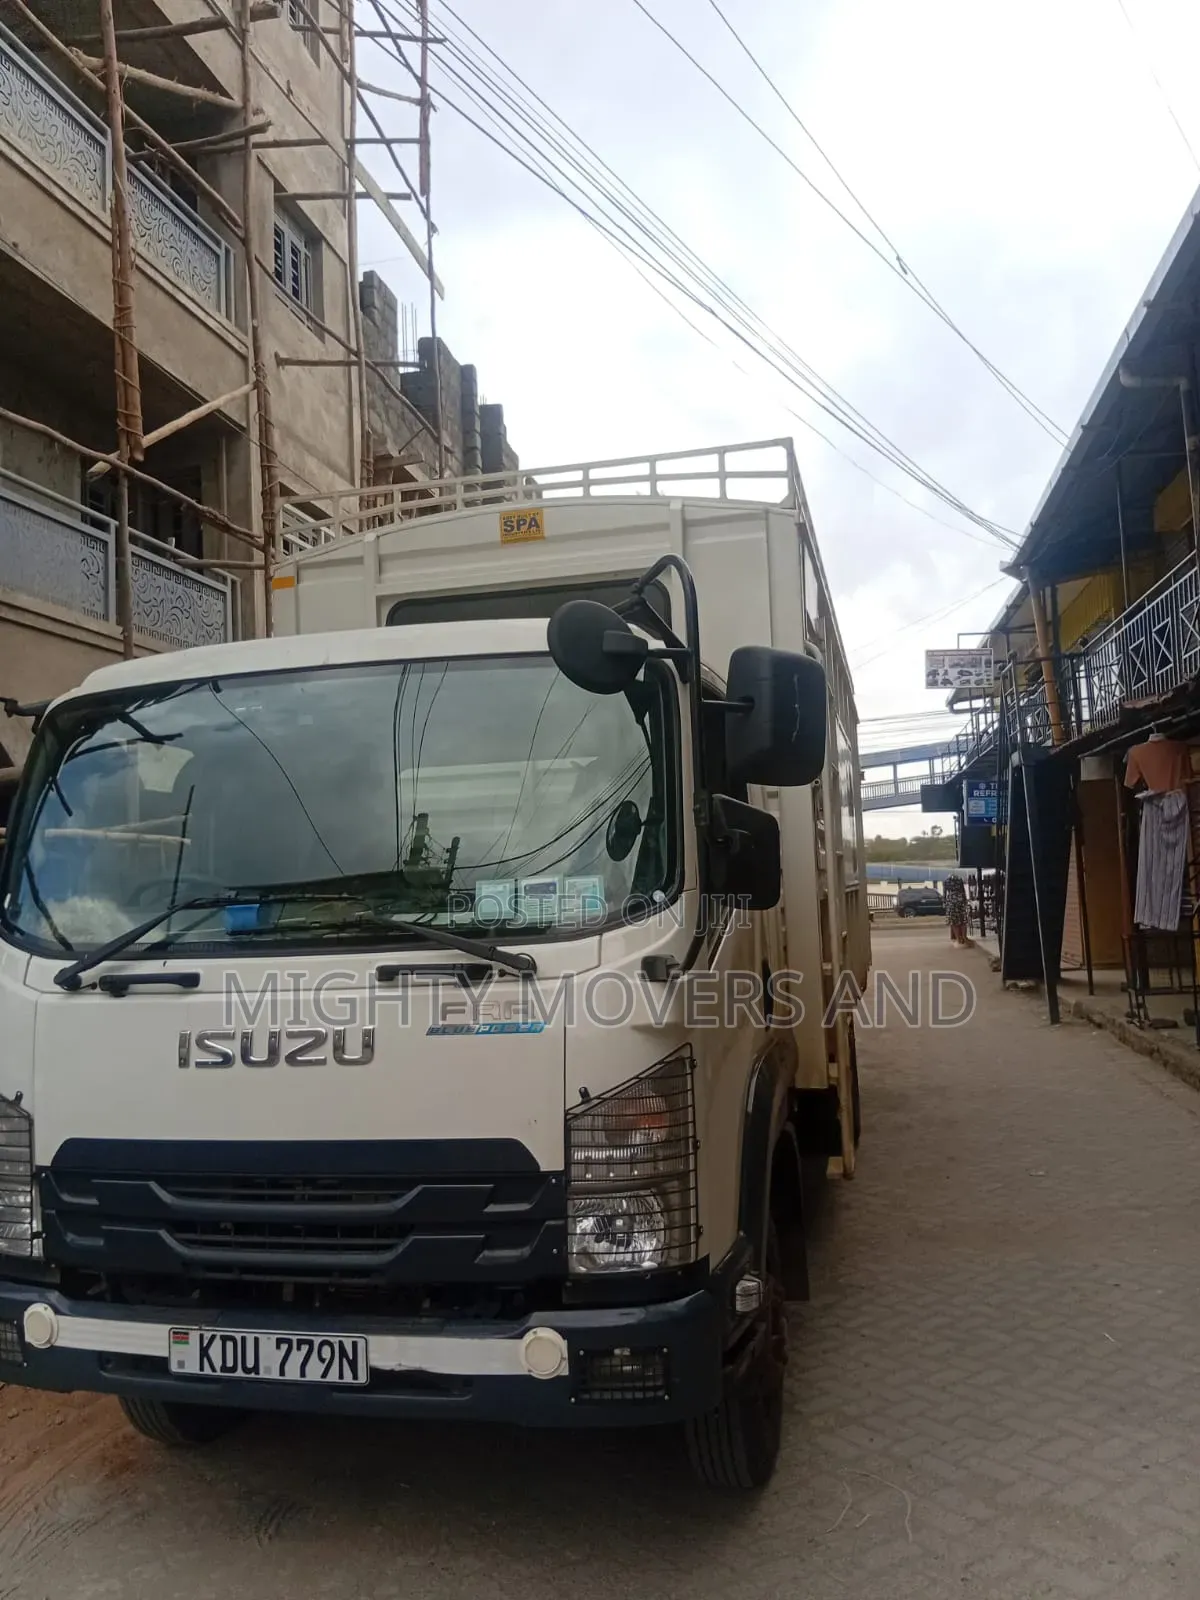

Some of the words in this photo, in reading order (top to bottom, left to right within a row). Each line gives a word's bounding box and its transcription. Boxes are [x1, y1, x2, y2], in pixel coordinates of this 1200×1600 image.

[504, 517, 540, 532] SPA
[178, 1025, 376, 1069] ISUZU
[199, 1333, 261, 1376] KDU
[275, 1336, 359, 1381] 779N
